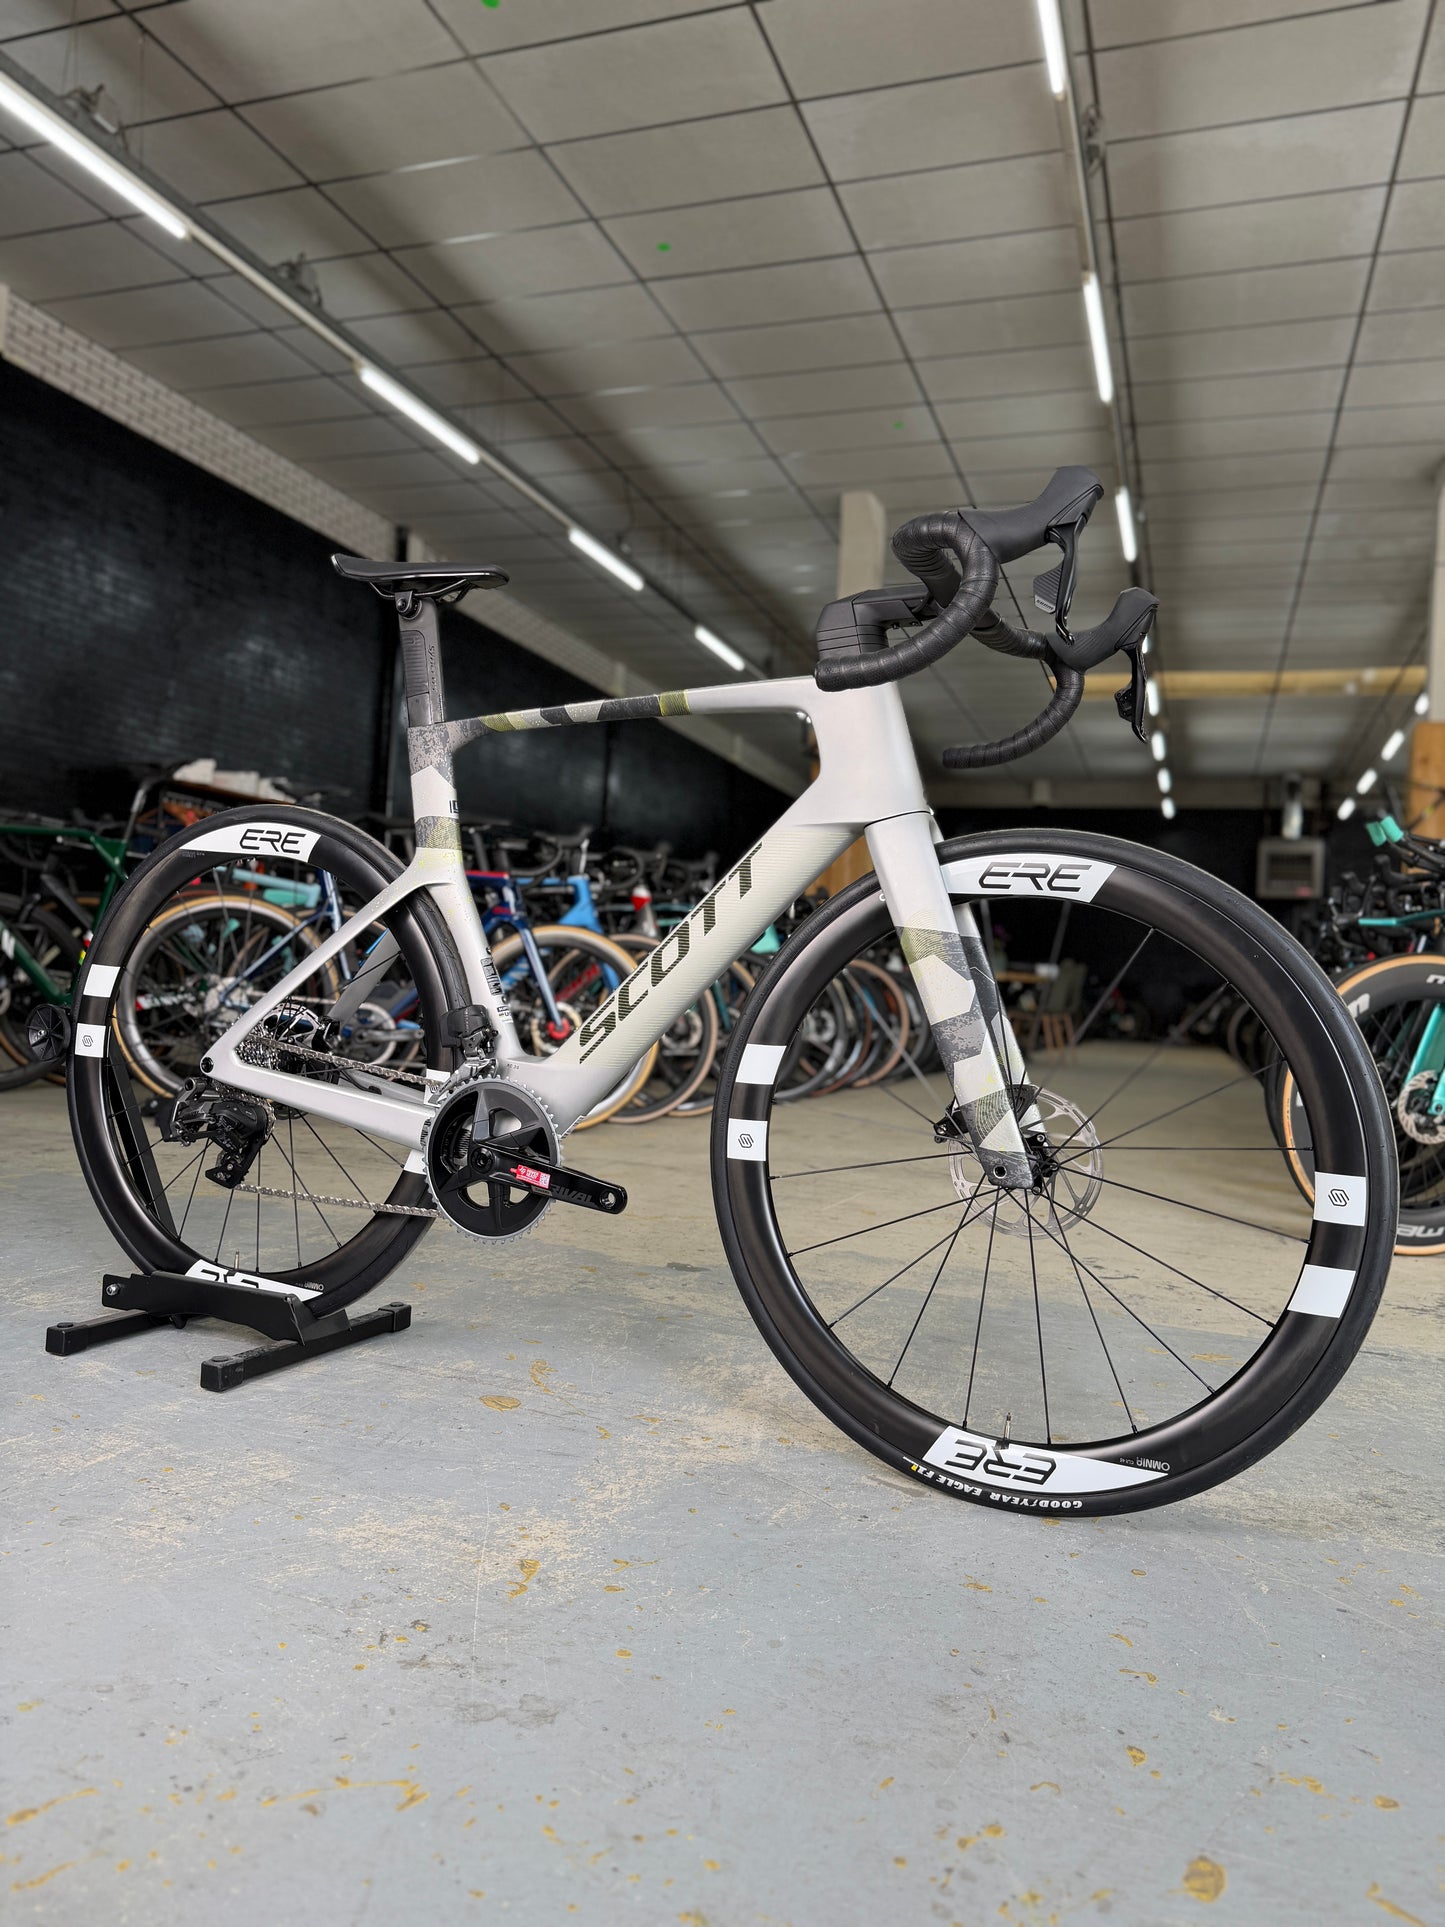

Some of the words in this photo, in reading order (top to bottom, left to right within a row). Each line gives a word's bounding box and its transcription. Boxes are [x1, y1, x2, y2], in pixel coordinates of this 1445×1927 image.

[240, 829, 306, 855] ERE
[978, 862, 1092, 892] ERE
[580, 842, 762, 1064] SCOTT
[944, 1439, 1057, 1485] ERE
[1136, 1456, 1170, 1471] OMNIA
[938, 1476, 983, 1496] EAGLE
[990, 1491, 1083, 1509] GOODYEAR
